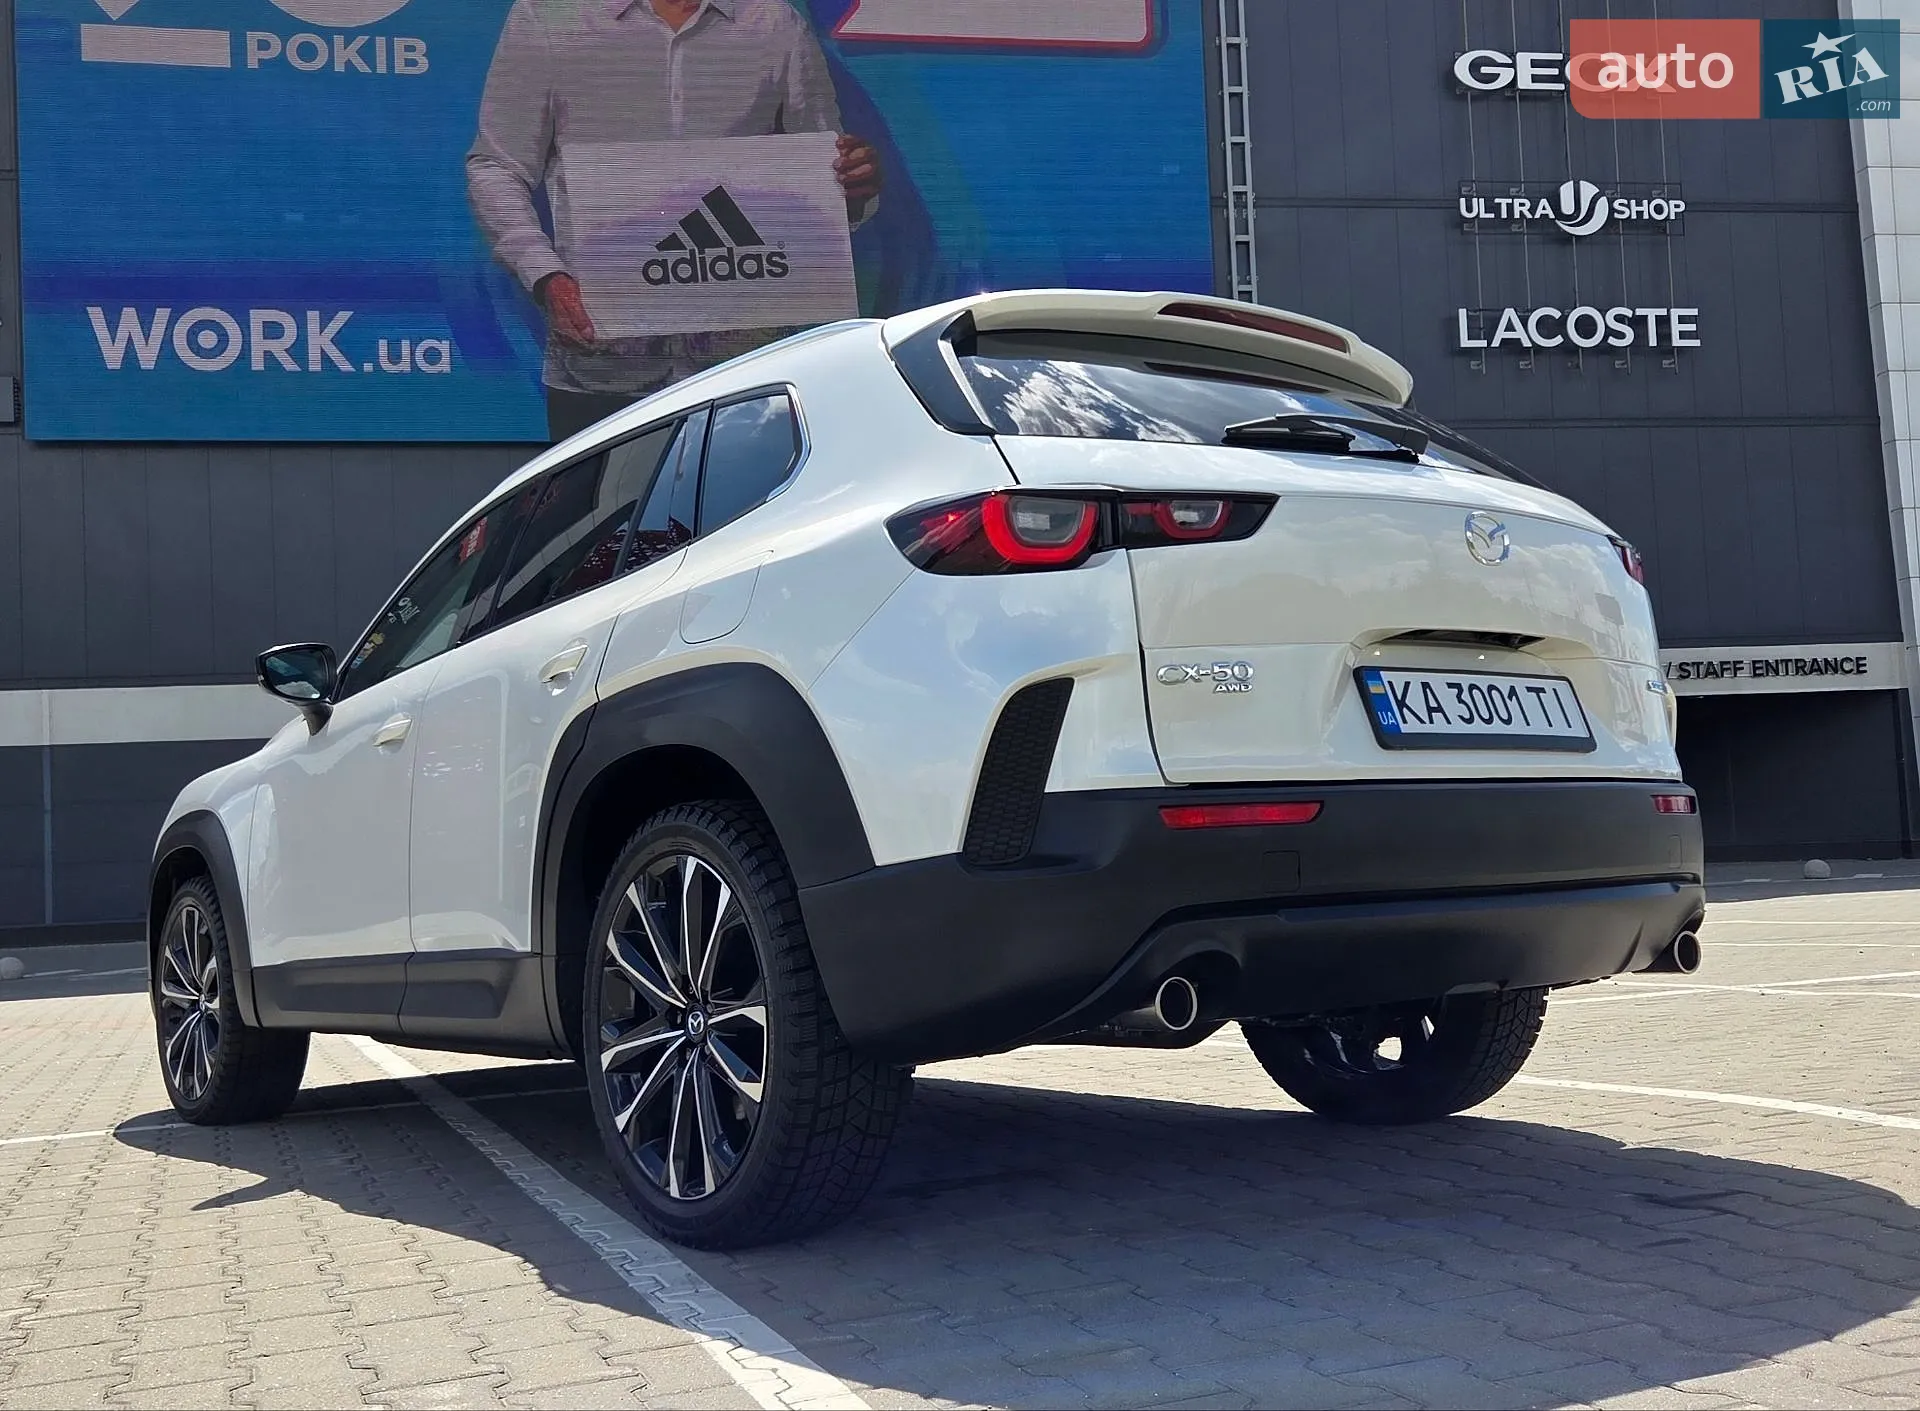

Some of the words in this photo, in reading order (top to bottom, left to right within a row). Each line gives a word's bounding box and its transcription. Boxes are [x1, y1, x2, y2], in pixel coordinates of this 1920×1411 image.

[247, 32, 430, 75] РОКІВ
[1459, 197, 1556, 219] ULTRA
[1612, 197, 1686, 221] SHOP
[642, 246, 790, 286] adidas
[1458, 305, 1702, 349] LACOSTE
[1156, 660, 1255, 686] CX-50
[1678, 660, 1745, 679] STAFF
[1752, 656, 1868, 677] ENTRANCE
[1214, 682, 1254, 694] AWD
[1387, 680, 1452, 725] KA
[1446, 681, 1531, 727] 3001
[1378, 711, 1398, 726] UA
